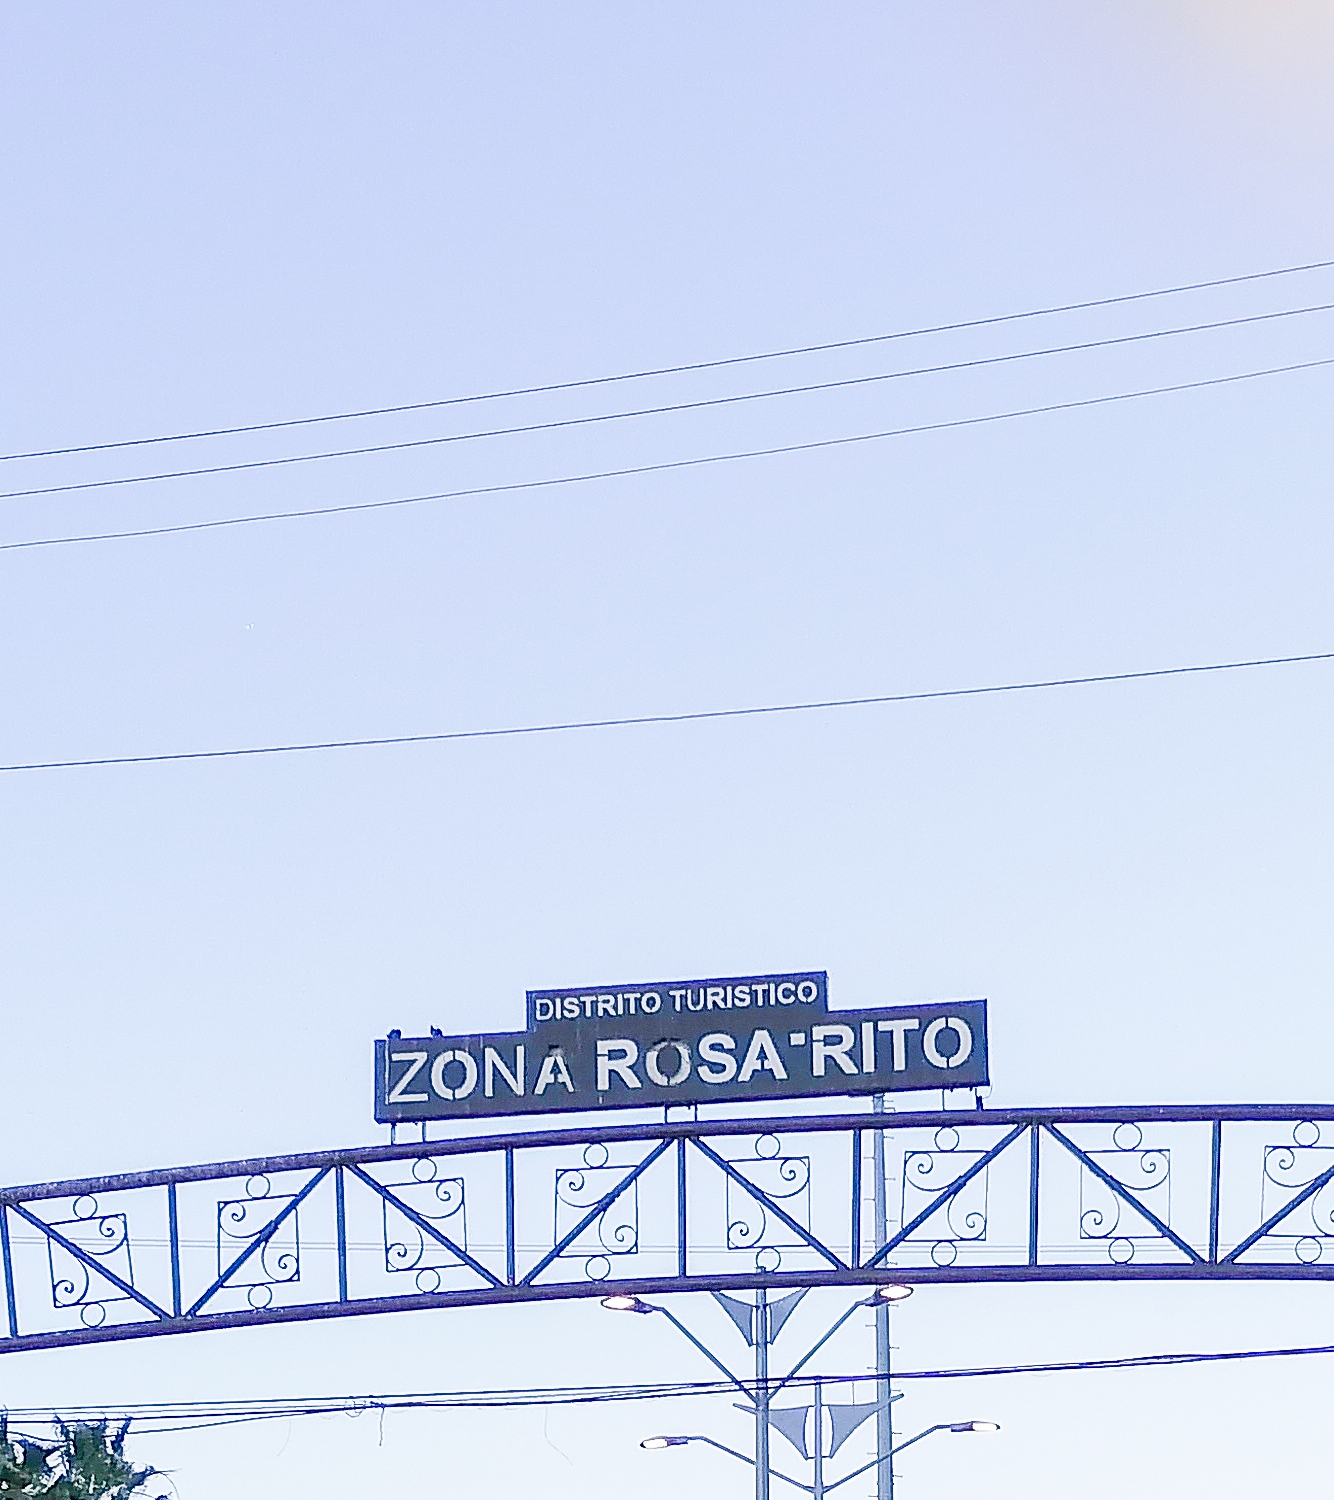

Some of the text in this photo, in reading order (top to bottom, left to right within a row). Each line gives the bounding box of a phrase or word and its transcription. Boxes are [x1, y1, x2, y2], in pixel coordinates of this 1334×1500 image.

[534, 980, 818, 1021] DISTRITO TURISTICO
[387, 1044, 575, 1104] ZONA
